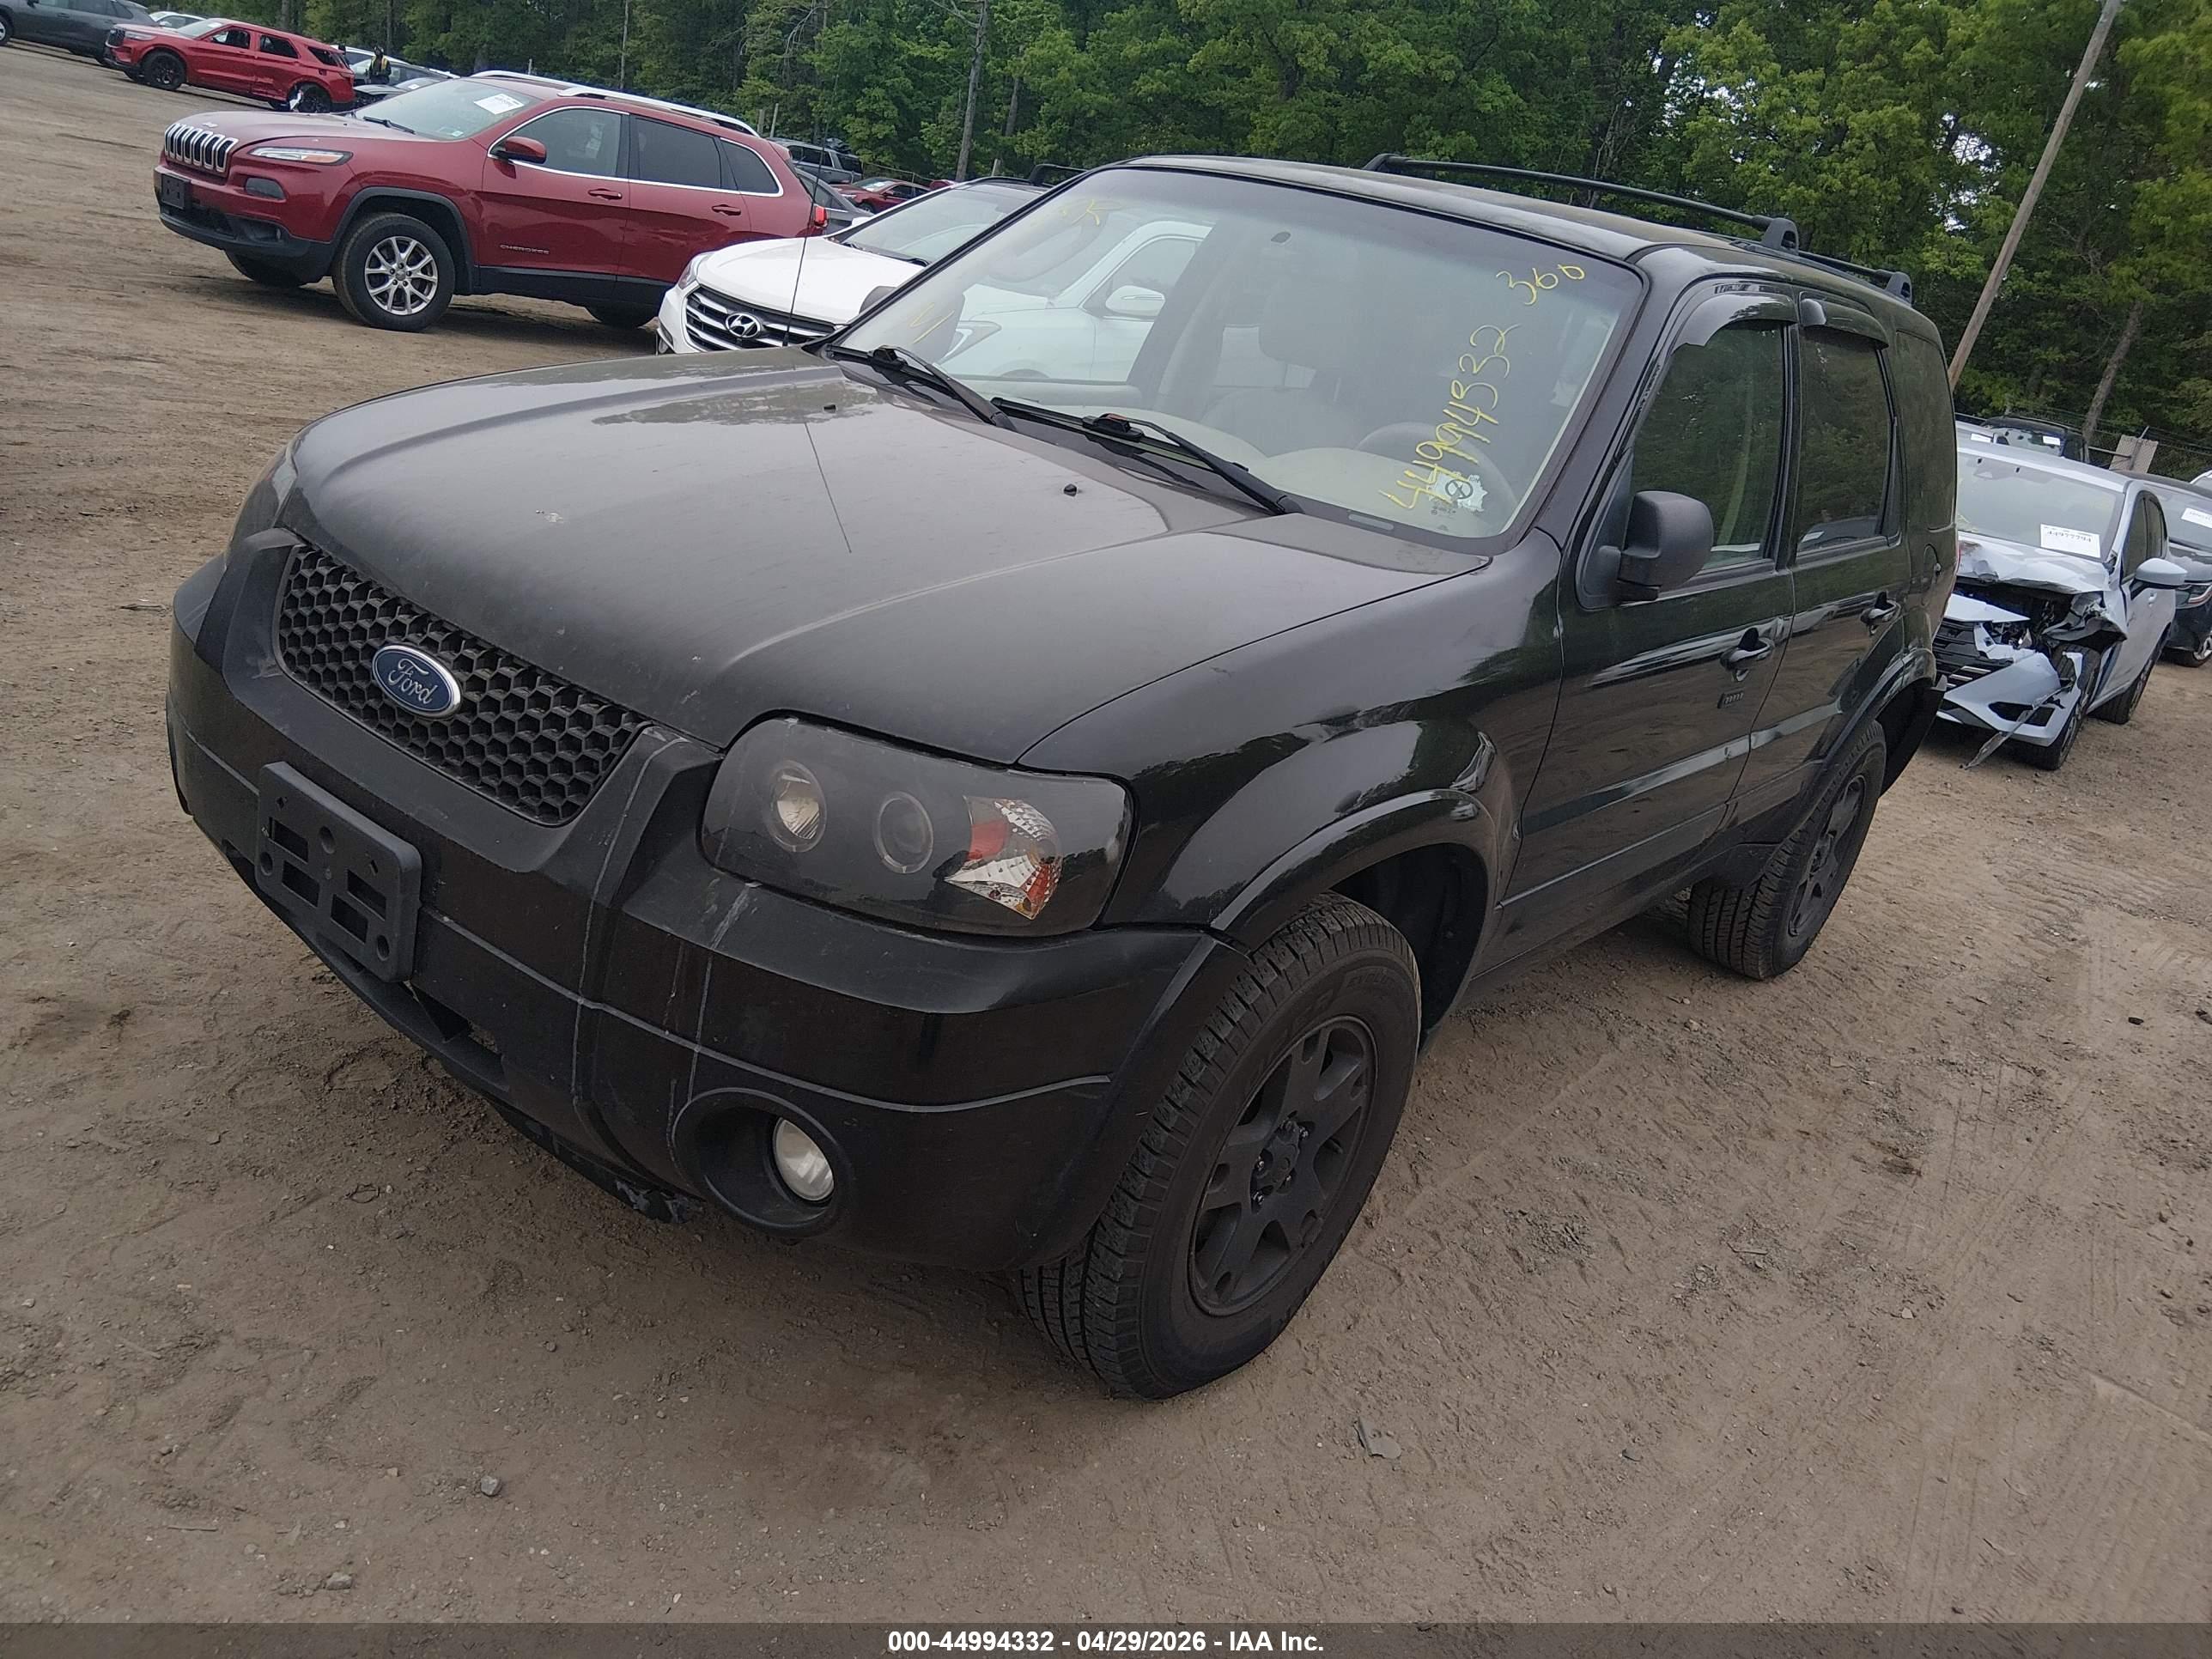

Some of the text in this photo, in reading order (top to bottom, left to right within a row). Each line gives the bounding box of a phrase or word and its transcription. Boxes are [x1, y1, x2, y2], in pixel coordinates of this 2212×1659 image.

[1378, 264, 1586, 509] 44994332 360
[388, 658, 439, 704] Ford
